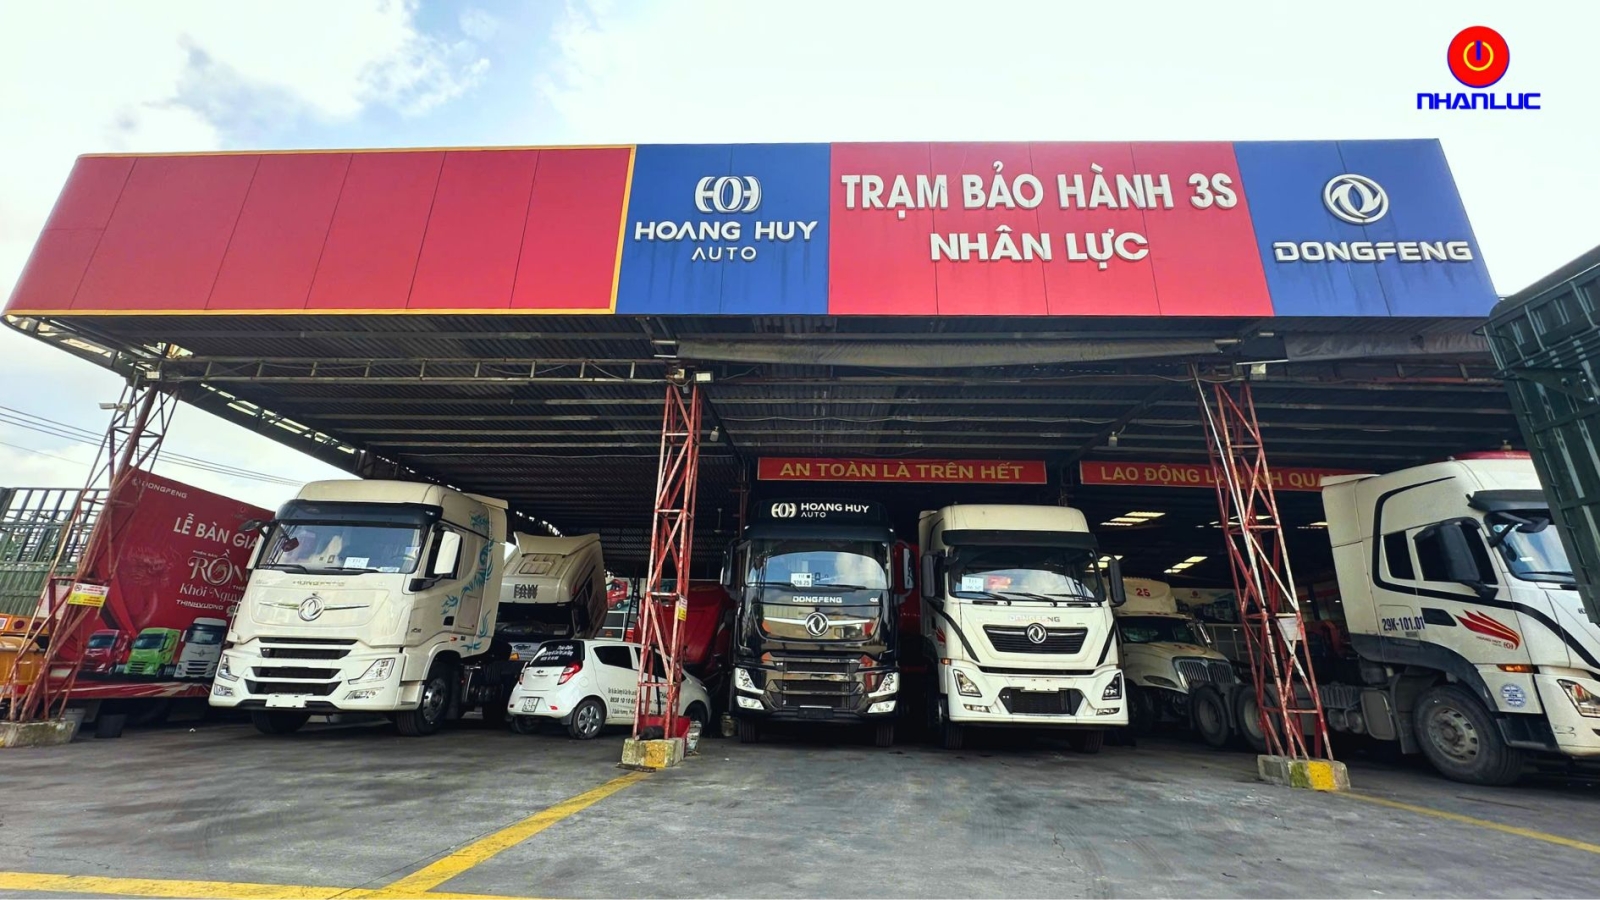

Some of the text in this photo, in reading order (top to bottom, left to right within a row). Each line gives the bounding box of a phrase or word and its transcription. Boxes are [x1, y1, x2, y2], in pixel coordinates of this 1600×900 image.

[841, 160, 1238, 220] TRẠM BẢO HÀNH 3S
[634, 220, 818, 241] HOANG HUY
[691, 246, 757, 261] AUTO
[929, 224, 1150, 270] NHÂN LỰC
[1272, 240, 1474, 263] DONGFENG
[780, 461, 1024, 480] AN TOÀN LÀ TRÊN HẾT
[1101, 466, 1139, 481] LAO
[1144, 464, 1201, 485] ĐỘNG
[800, 502, 870, 513] HOANG HUY
[173, 513, 195, 536] LỄ
[194, 521, 230, 544] BÀN
[792, 596, 843, 604] DONGFENG
[1381, 616, 1426, 632] 29K-101.01
